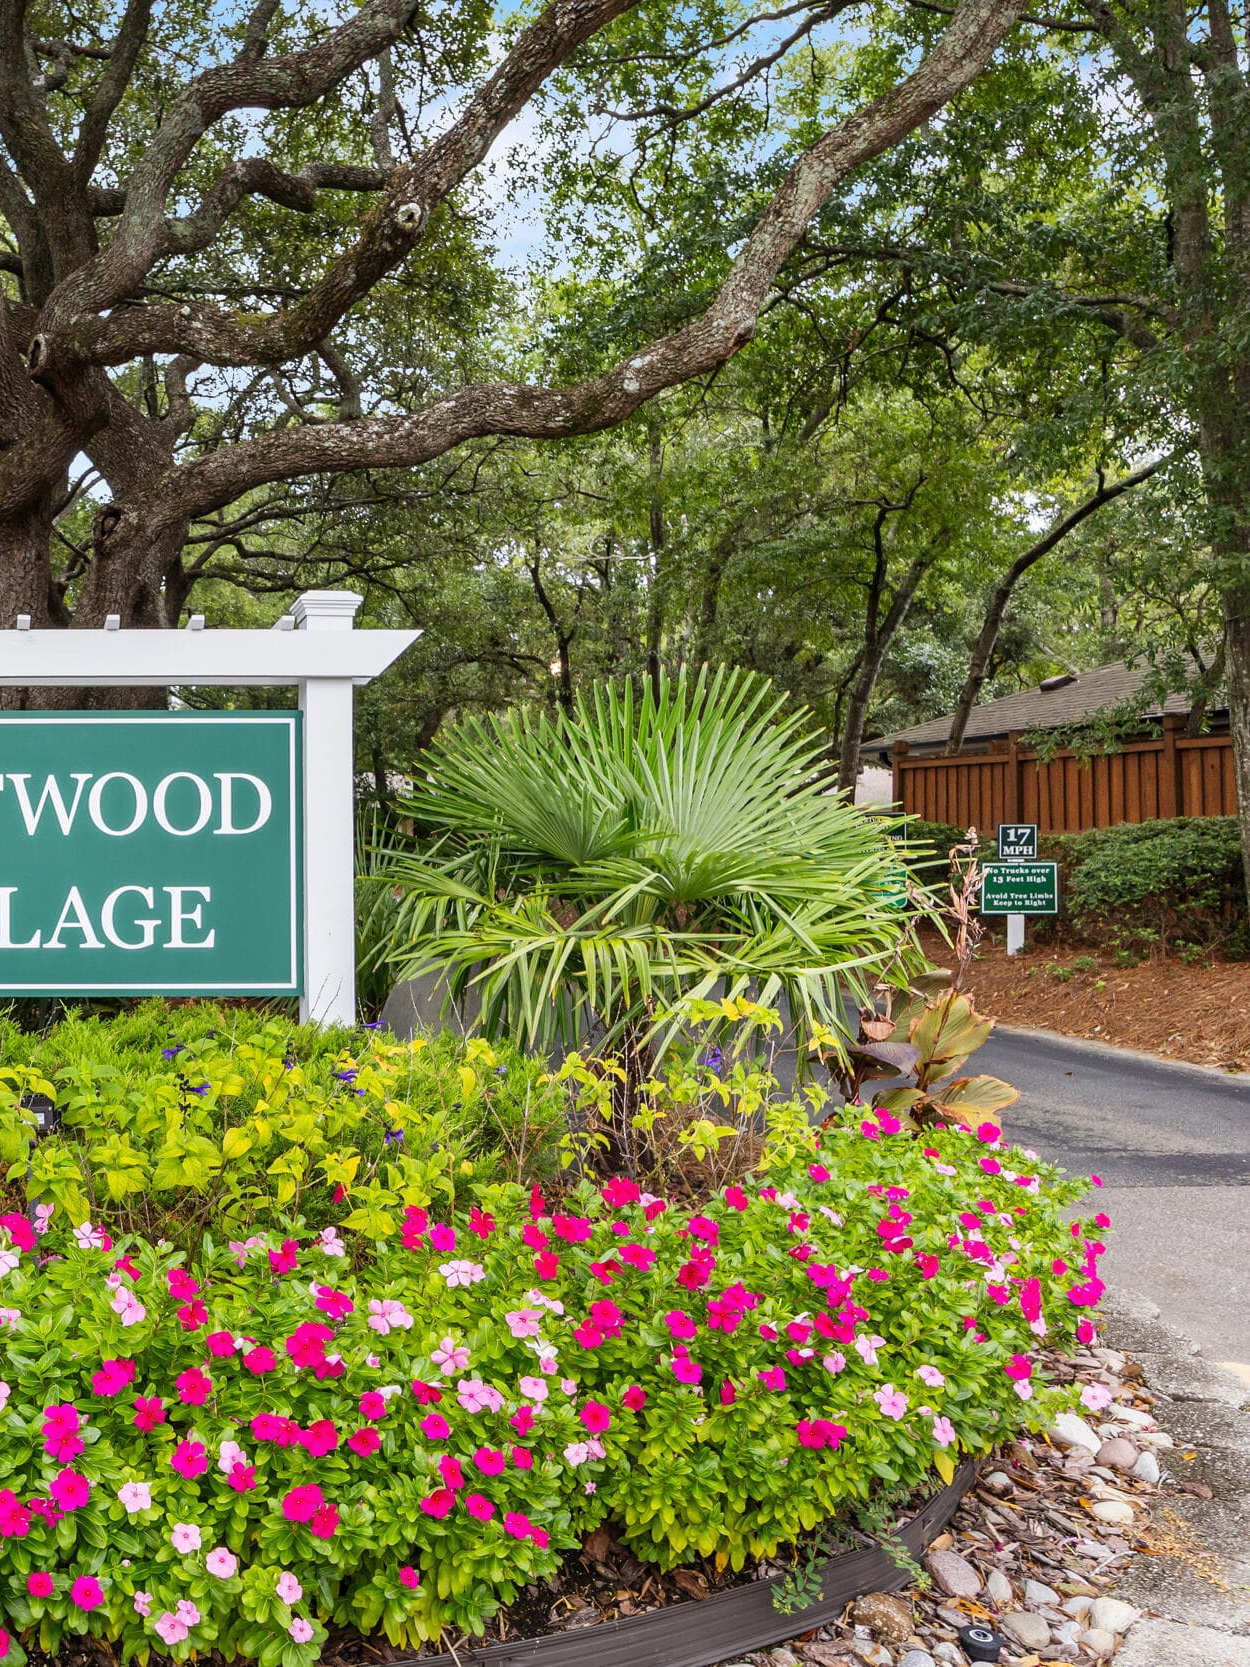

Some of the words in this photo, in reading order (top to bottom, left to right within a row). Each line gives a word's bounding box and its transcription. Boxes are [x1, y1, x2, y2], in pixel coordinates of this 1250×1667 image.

[1006, 827, 1031, 845] 17
[1003, 845, 1033, 855] MPH
[1000, 866, 1029, 874] Trucks
[993, 876, 1004, 884] 13
[1026, 875, 1047, 884] High
[993, 899, 1013, 907] Keep
[1024, 899, 1046, 907] Right
